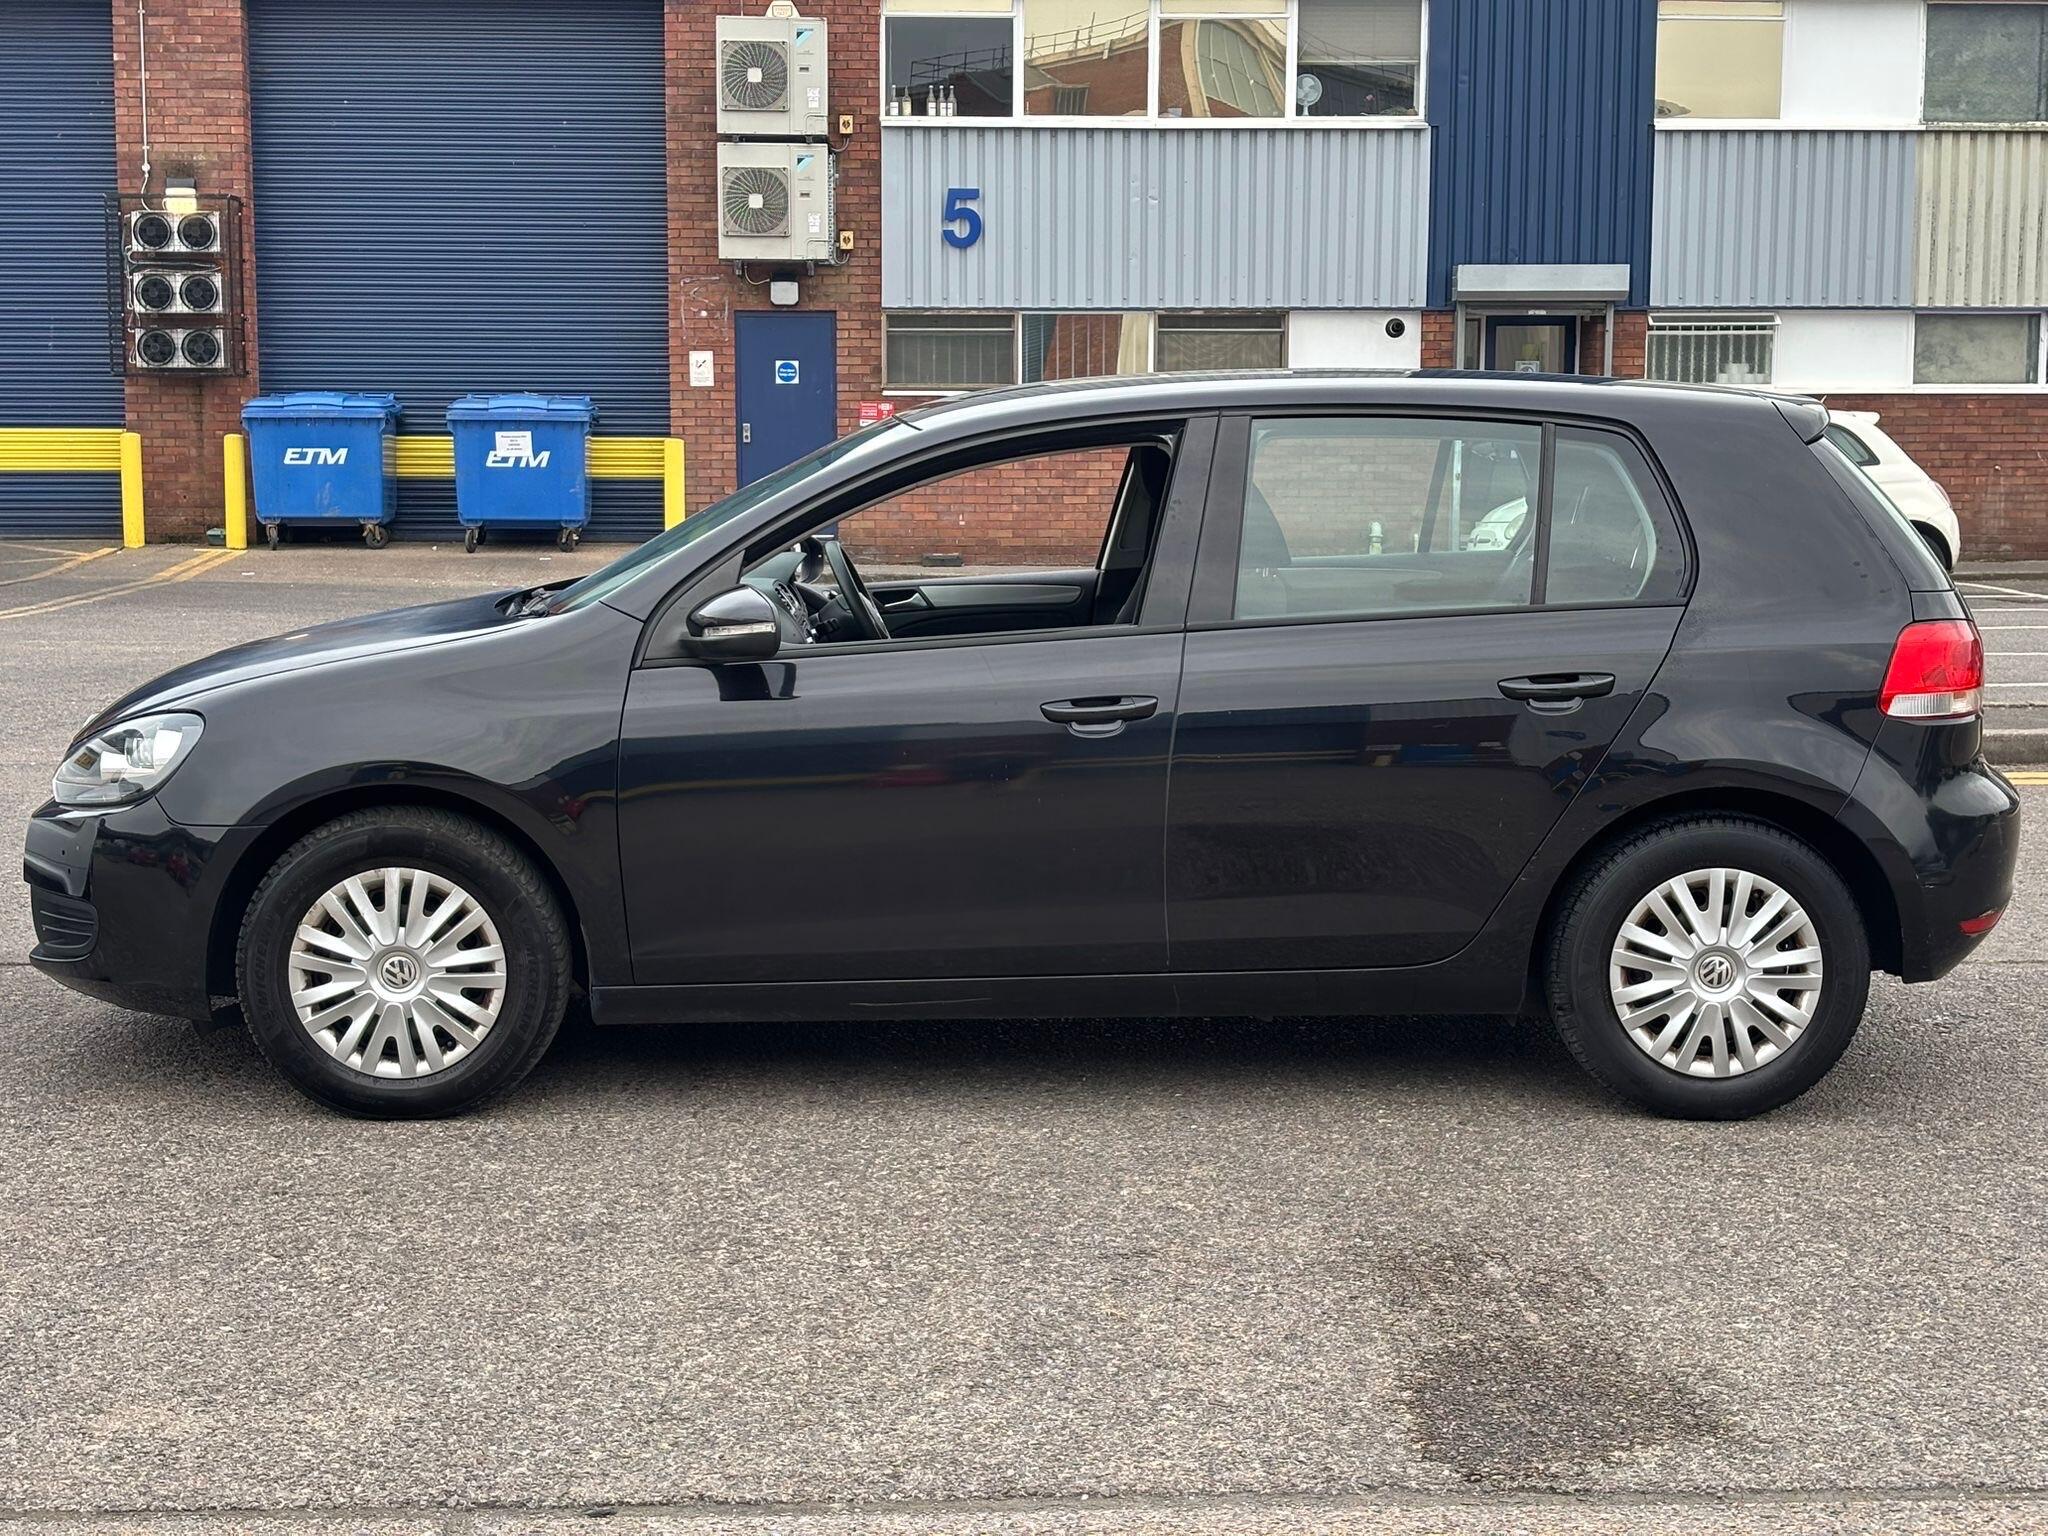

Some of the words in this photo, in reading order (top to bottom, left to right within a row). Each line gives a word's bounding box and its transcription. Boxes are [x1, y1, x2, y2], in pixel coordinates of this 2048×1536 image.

[943, 188, 981, 249] 5
[283, 447, 349, 465] ETM
[382, 955, 416, 988] VW
